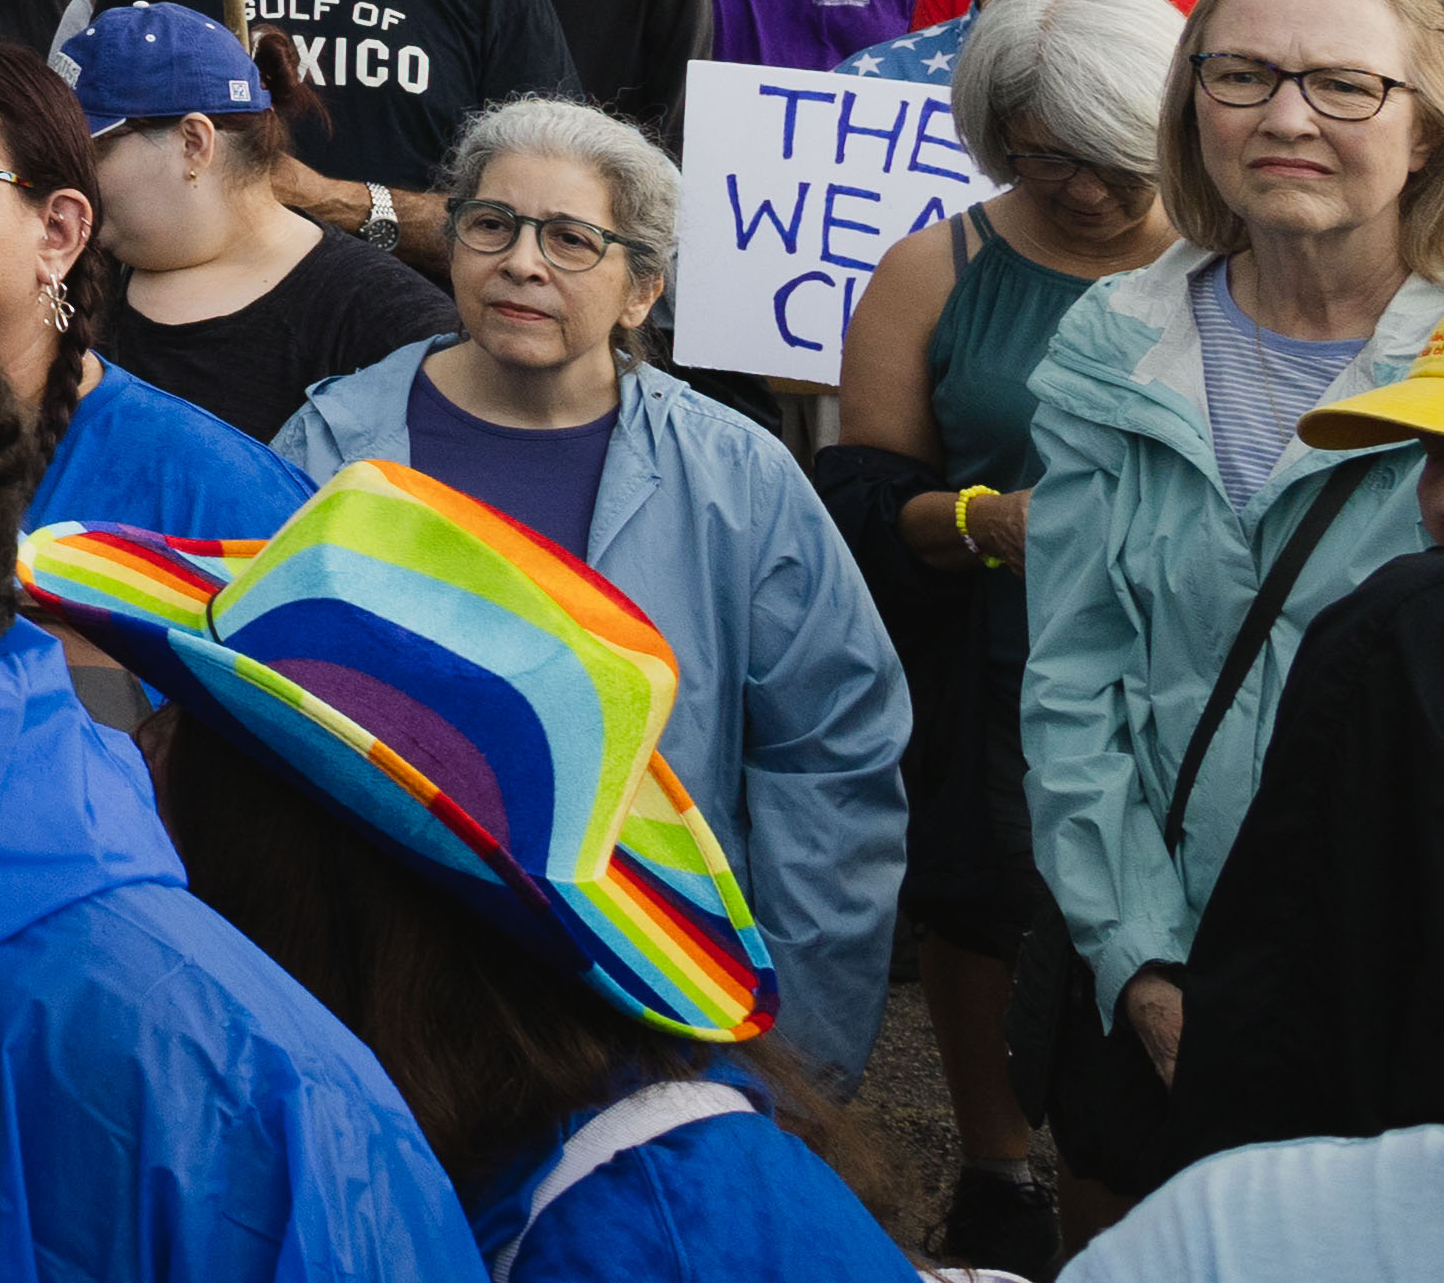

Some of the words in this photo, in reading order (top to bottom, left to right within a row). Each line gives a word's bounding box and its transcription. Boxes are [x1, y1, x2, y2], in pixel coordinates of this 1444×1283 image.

[352, 1, 406, 30] OF
[292, 34, 429, 94] XICO
[759, 84, 970, 184] THE
